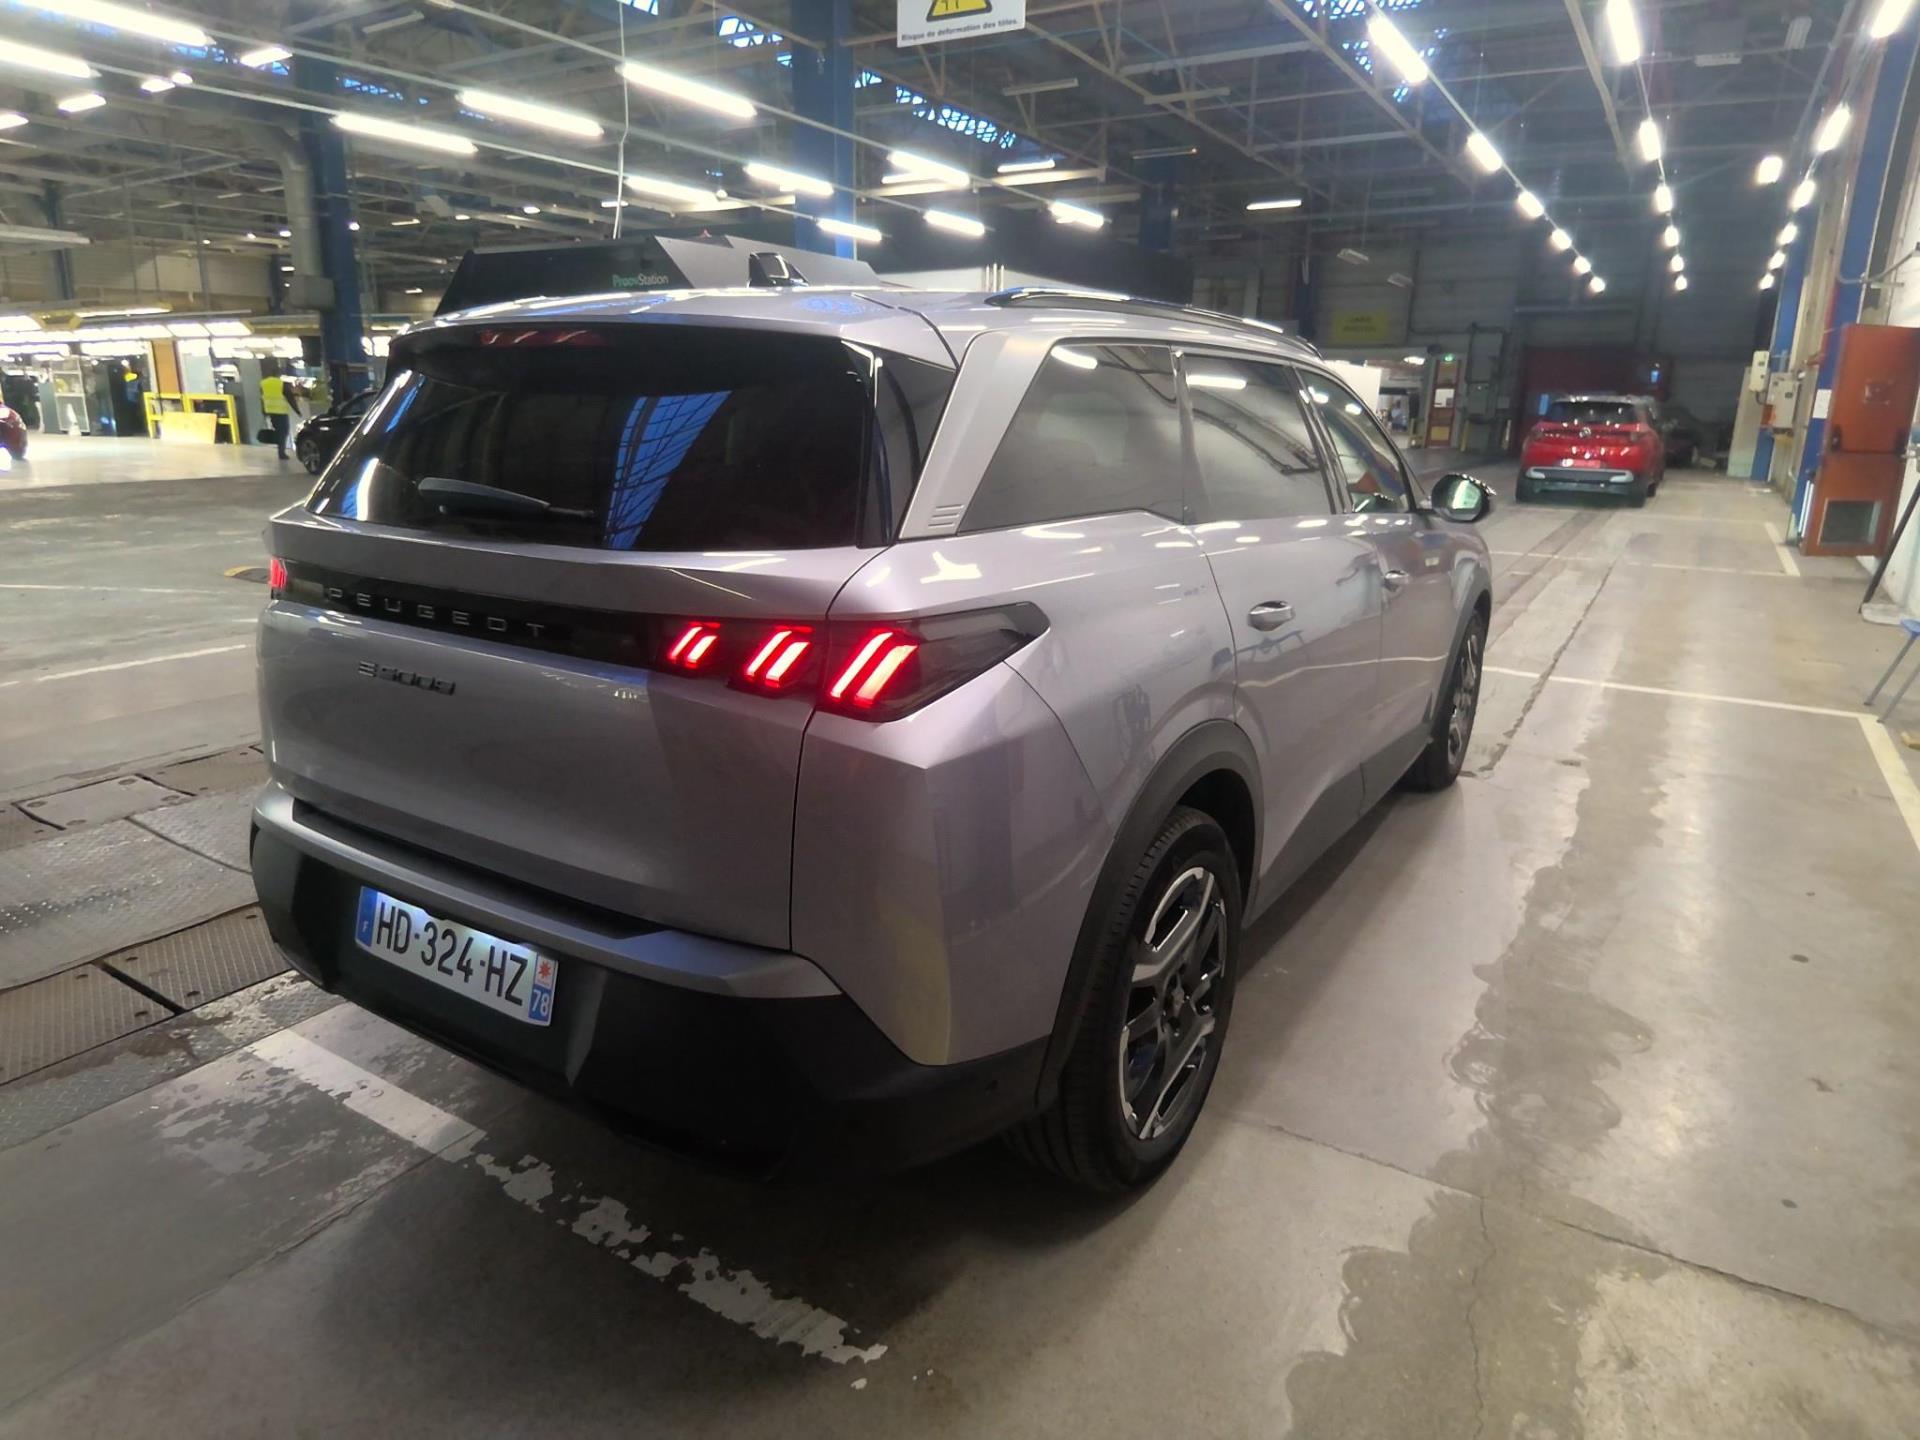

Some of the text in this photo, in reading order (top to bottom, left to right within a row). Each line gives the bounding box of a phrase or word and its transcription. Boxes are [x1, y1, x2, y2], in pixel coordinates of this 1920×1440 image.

[927, 29, 936, 37] de
[983, 20, 996, 29] des
[328, 587, 545, 637] PEUGEOT
[532, 988, 550, 1017] 78
